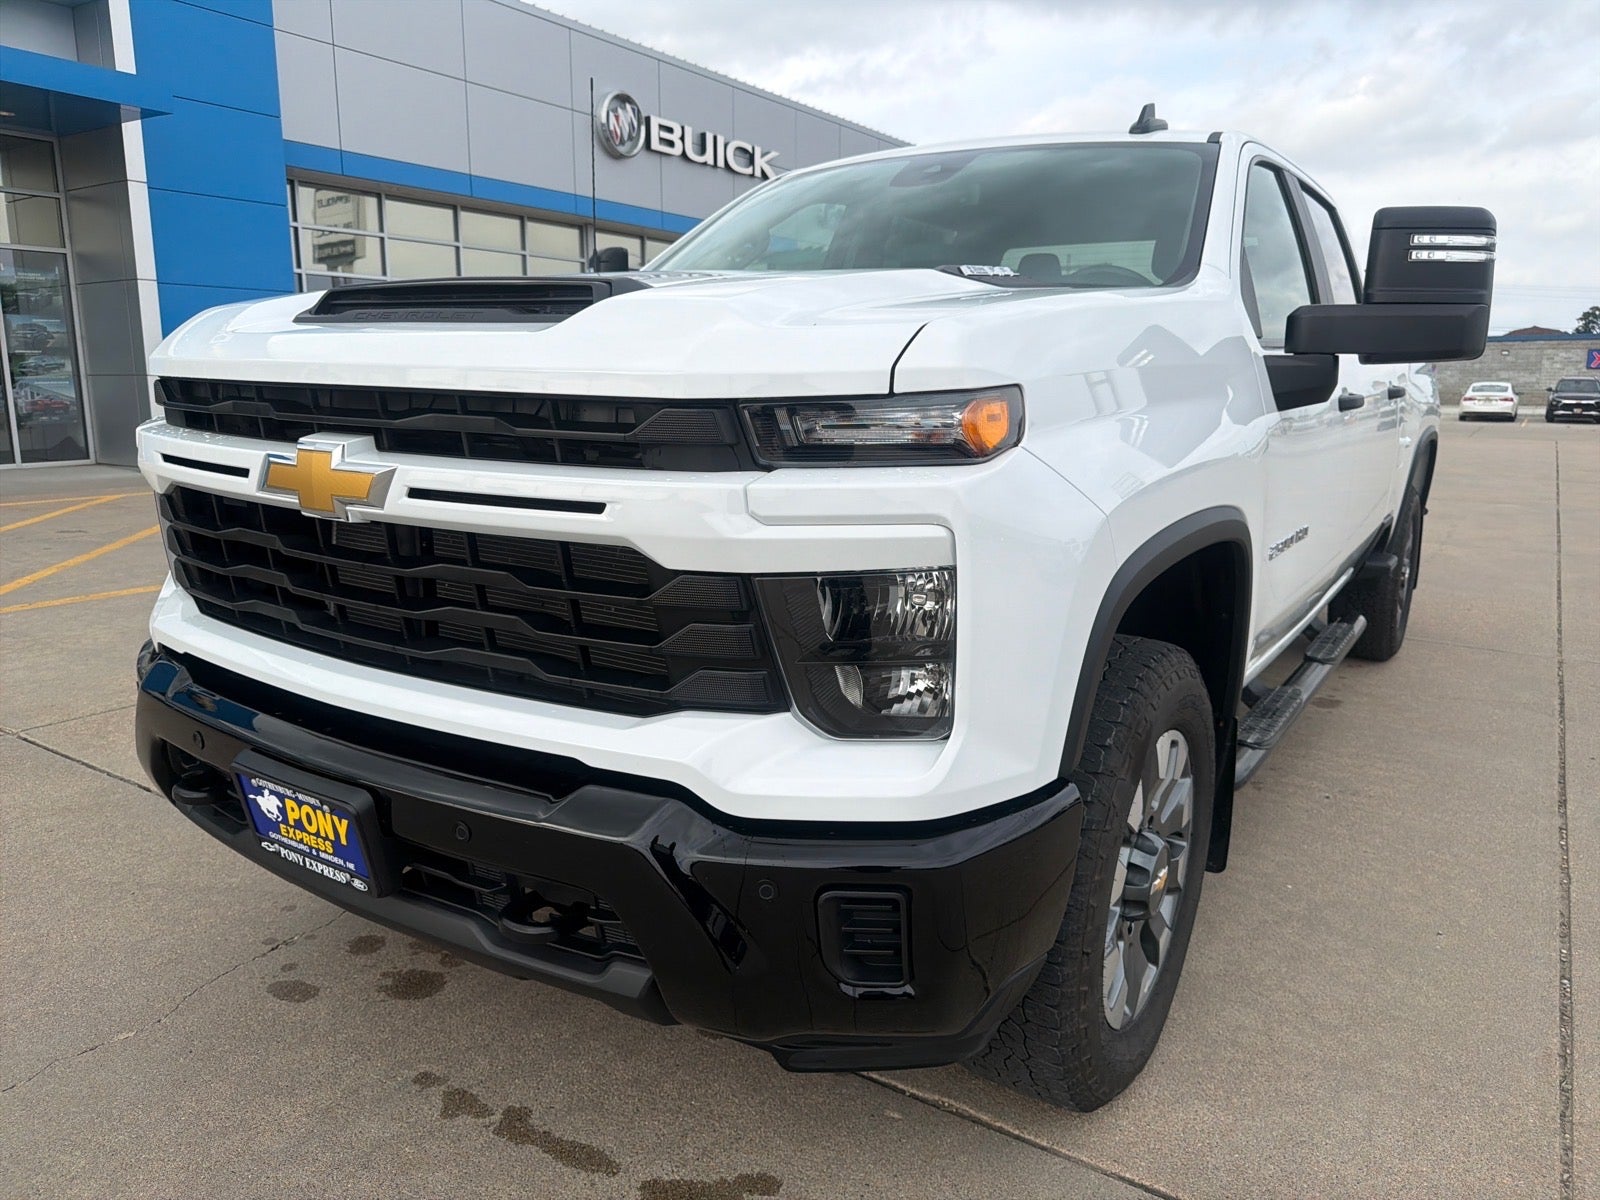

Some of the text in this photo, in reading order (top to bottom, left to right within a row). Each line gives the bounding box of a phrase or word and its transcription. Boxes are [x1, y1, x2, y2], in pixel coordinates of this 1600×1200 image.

[647, 114, 779, 180] BUICK
[353, 310, 484, 321] CHEVROLET
[279, 823, 334, 854] EXPRESS
[284, 798, 349, 846] PONY
[268, 831, 310, 853] GOTHENBURG
[280, 846, 347, 884] PONY EXPRESS
